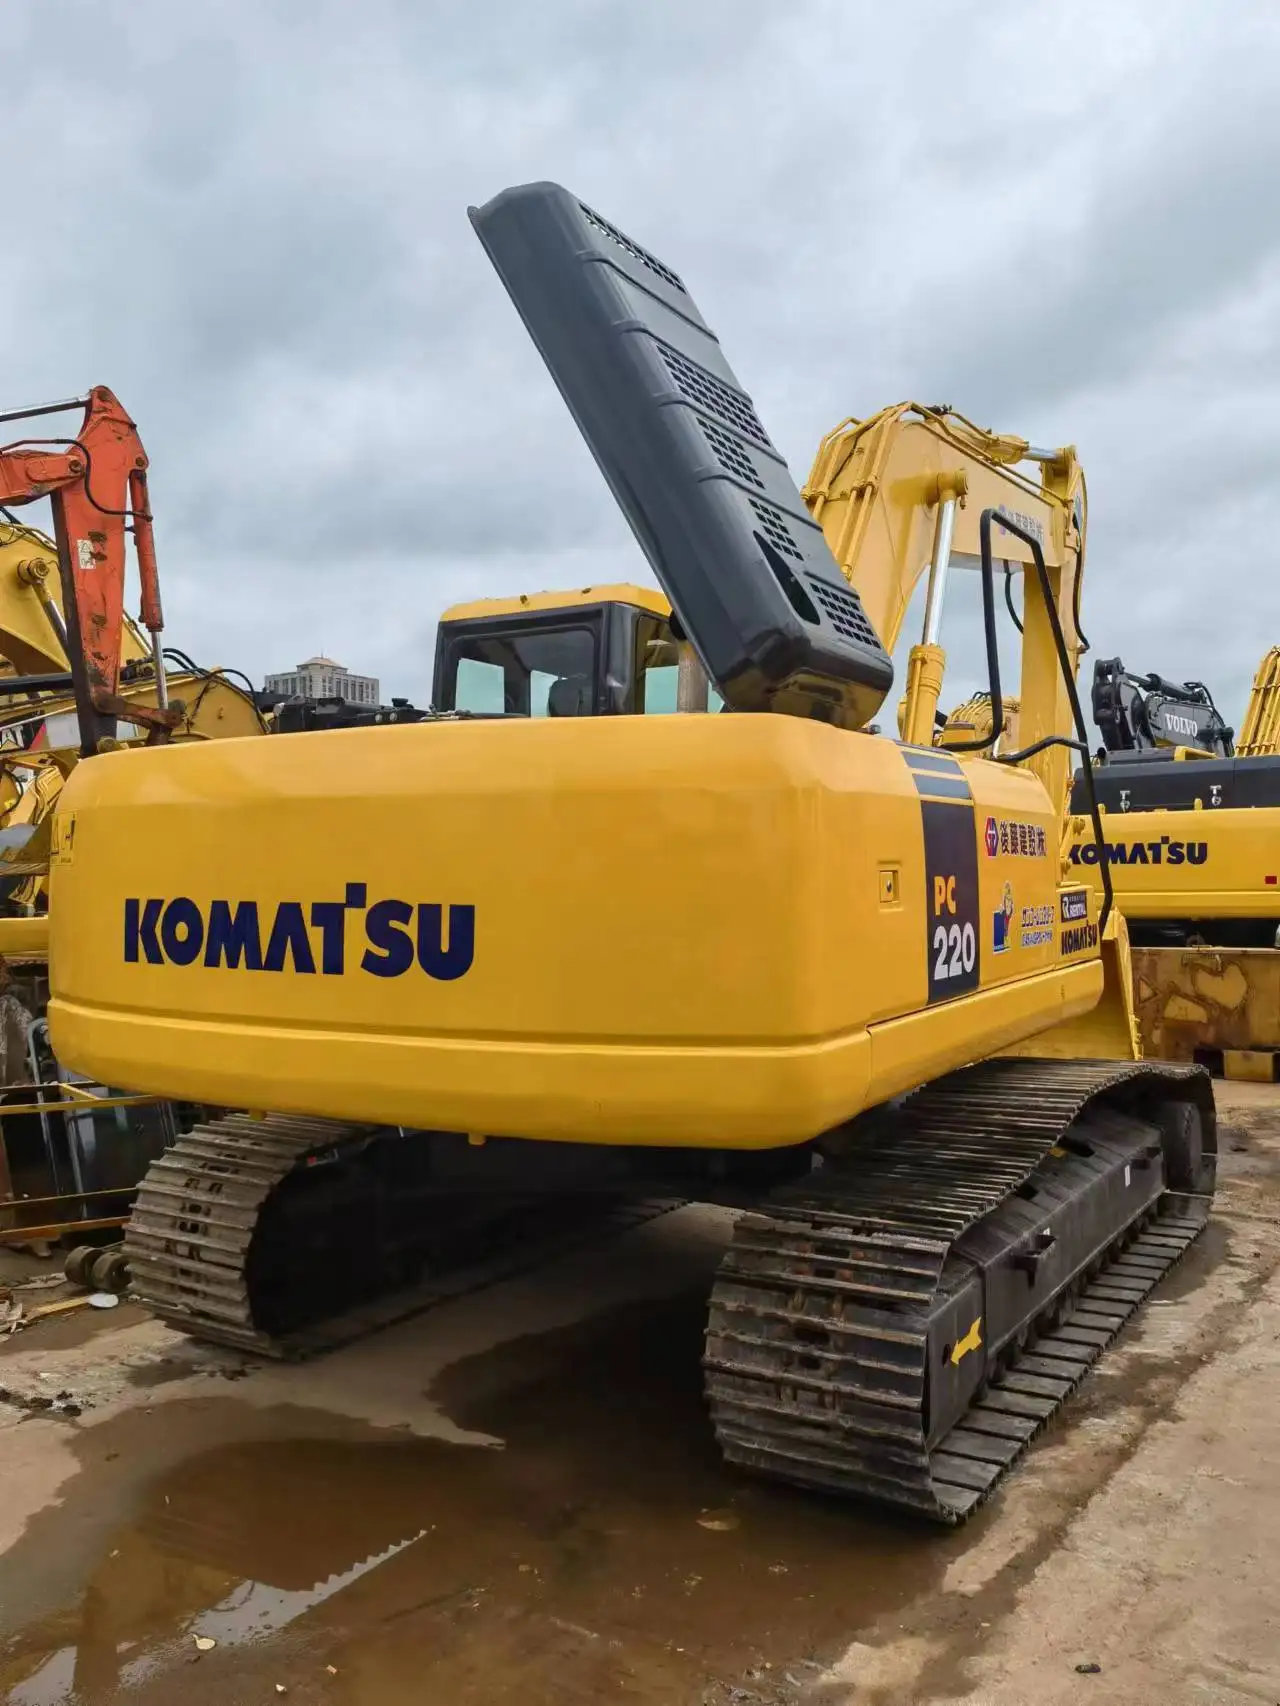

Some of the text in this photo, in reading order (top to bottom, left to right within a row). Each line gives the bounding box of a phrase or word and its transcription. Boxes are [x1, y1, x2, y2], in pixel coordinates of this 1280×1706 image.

[1165, 713, 1198, 738] VOLVO
[934, 875, 956, 916] PC
[124, 882, 475, 981] KOMATSU
[933, 921, 976, 981] 220
[1061, 920, 1098, 956] KOMATSU
